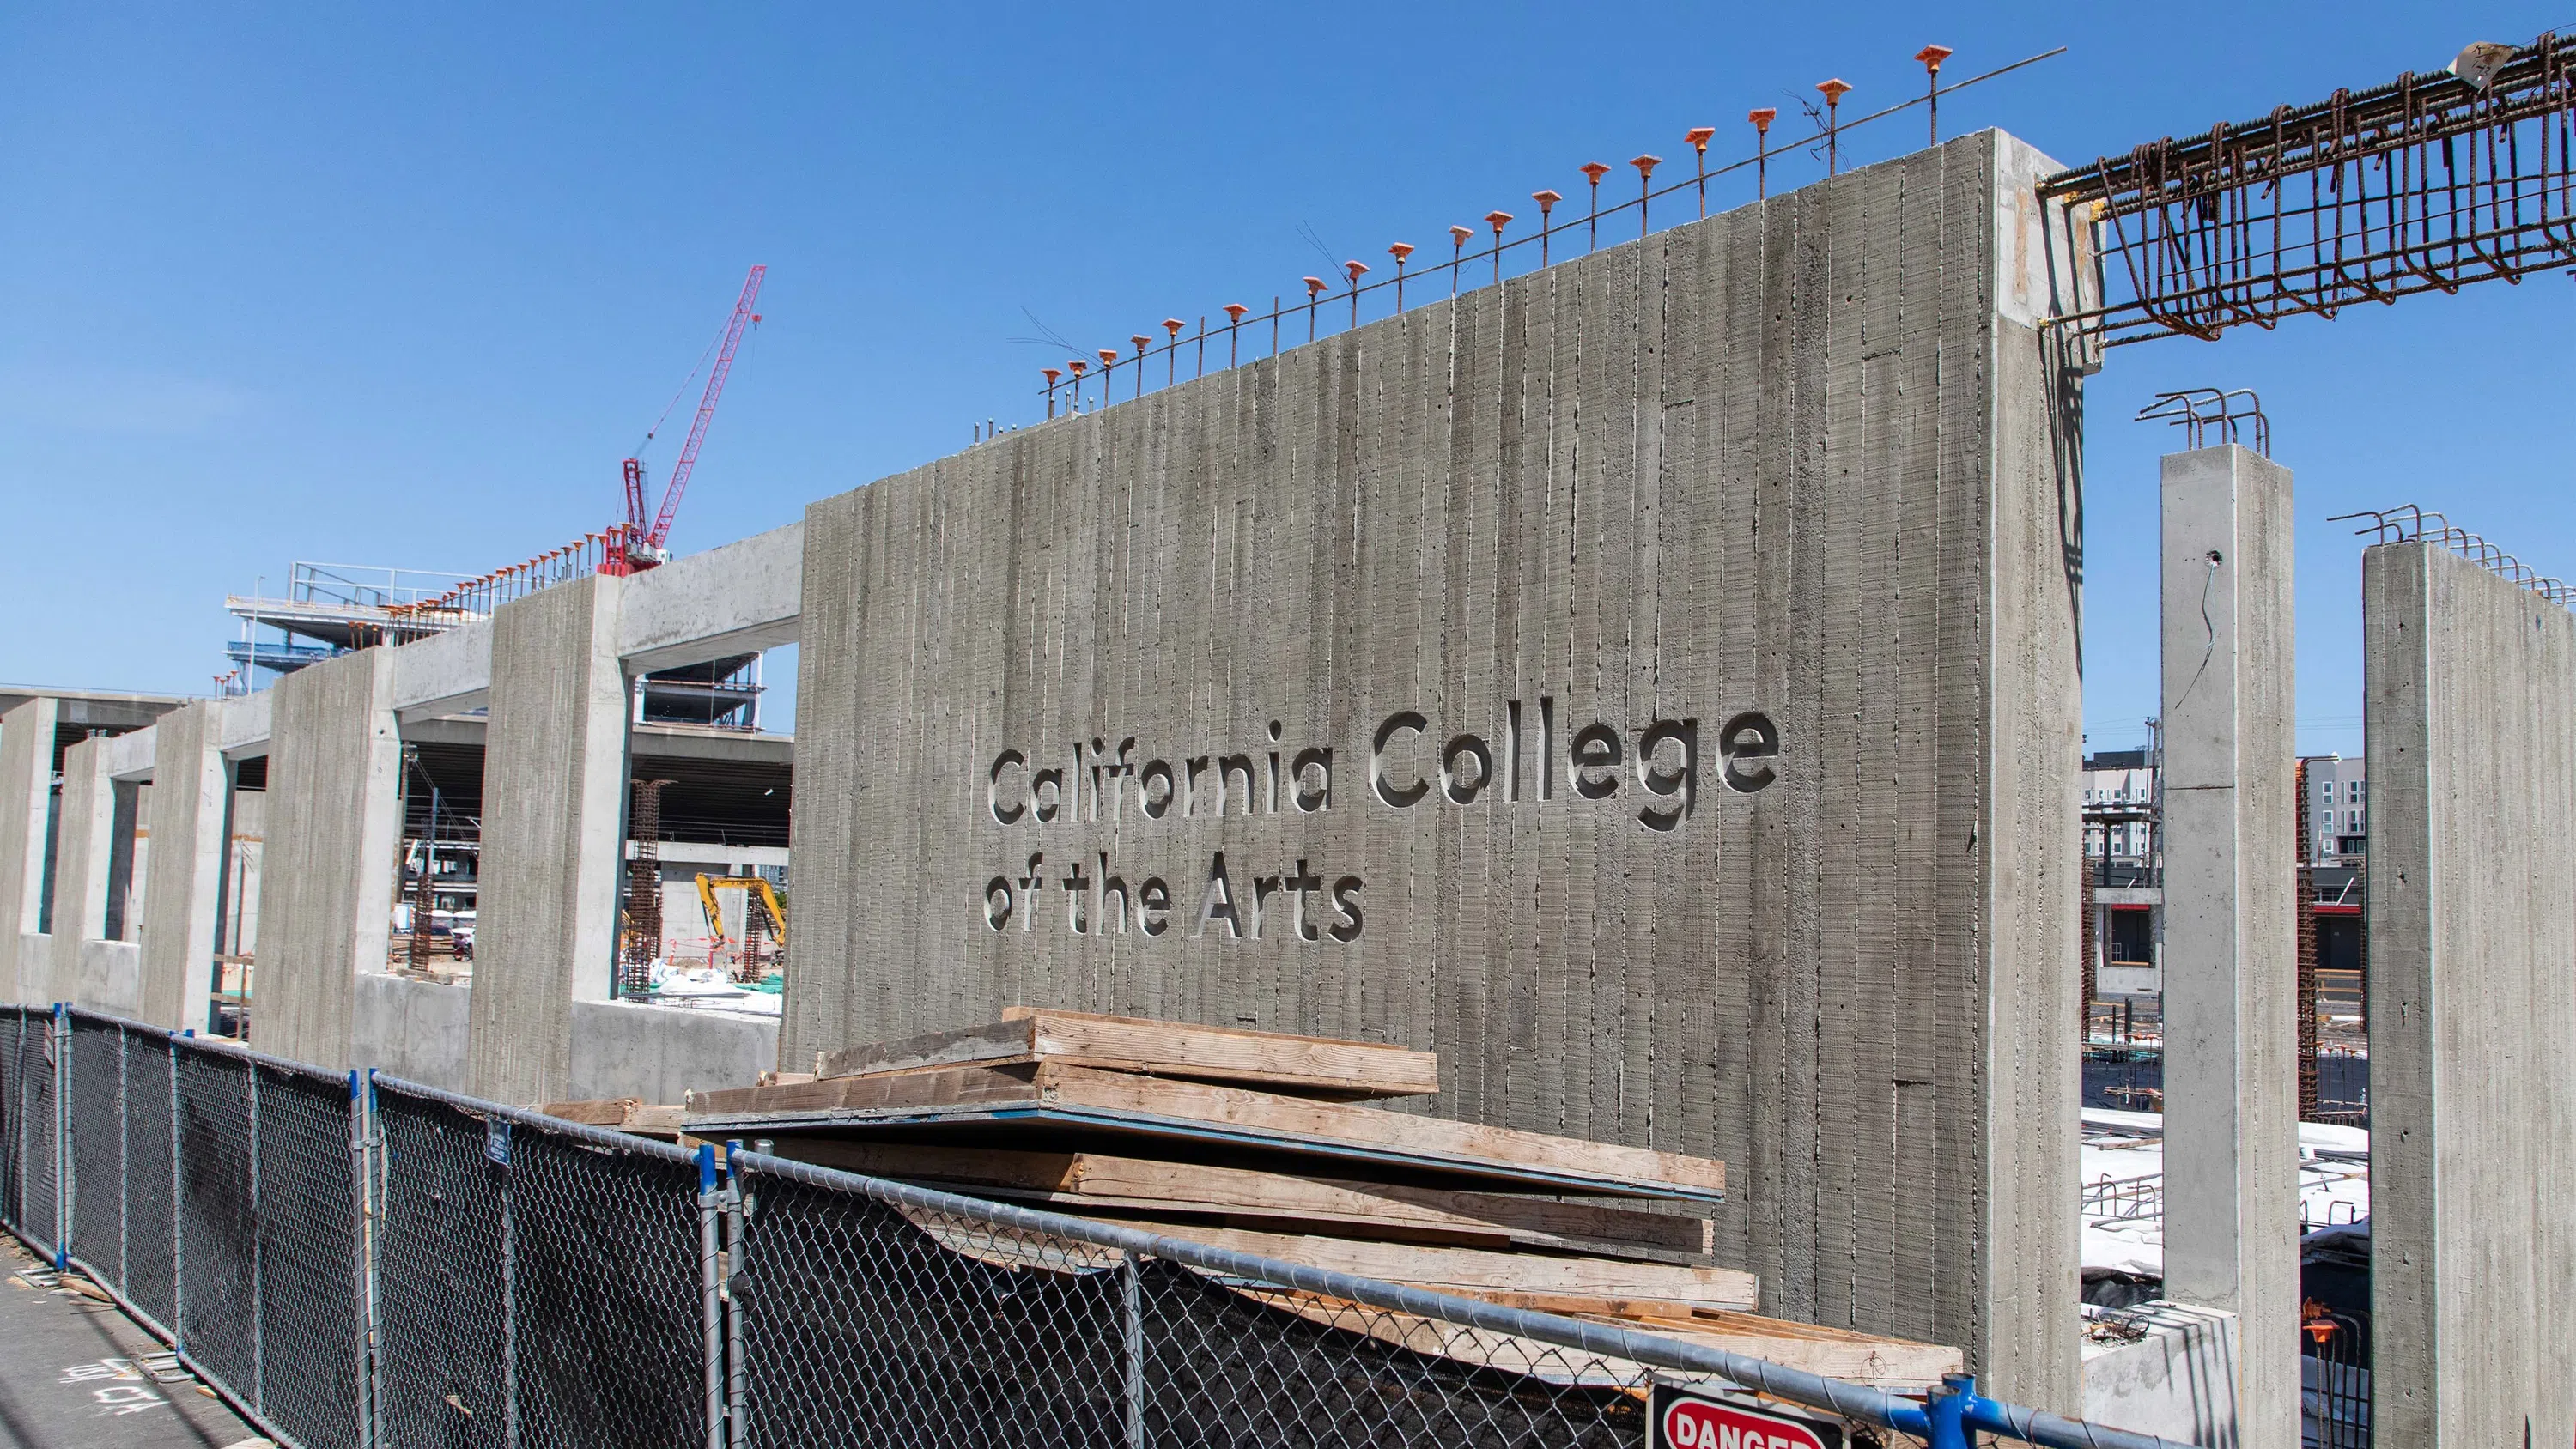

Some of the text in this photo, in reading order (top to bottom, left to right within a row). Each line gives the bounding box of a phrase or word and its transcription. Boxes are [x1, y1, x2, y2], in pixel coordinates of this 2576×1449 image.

[990, 697, 1778, 833] California College
[986, 852, 1364, 943] of the Arts
